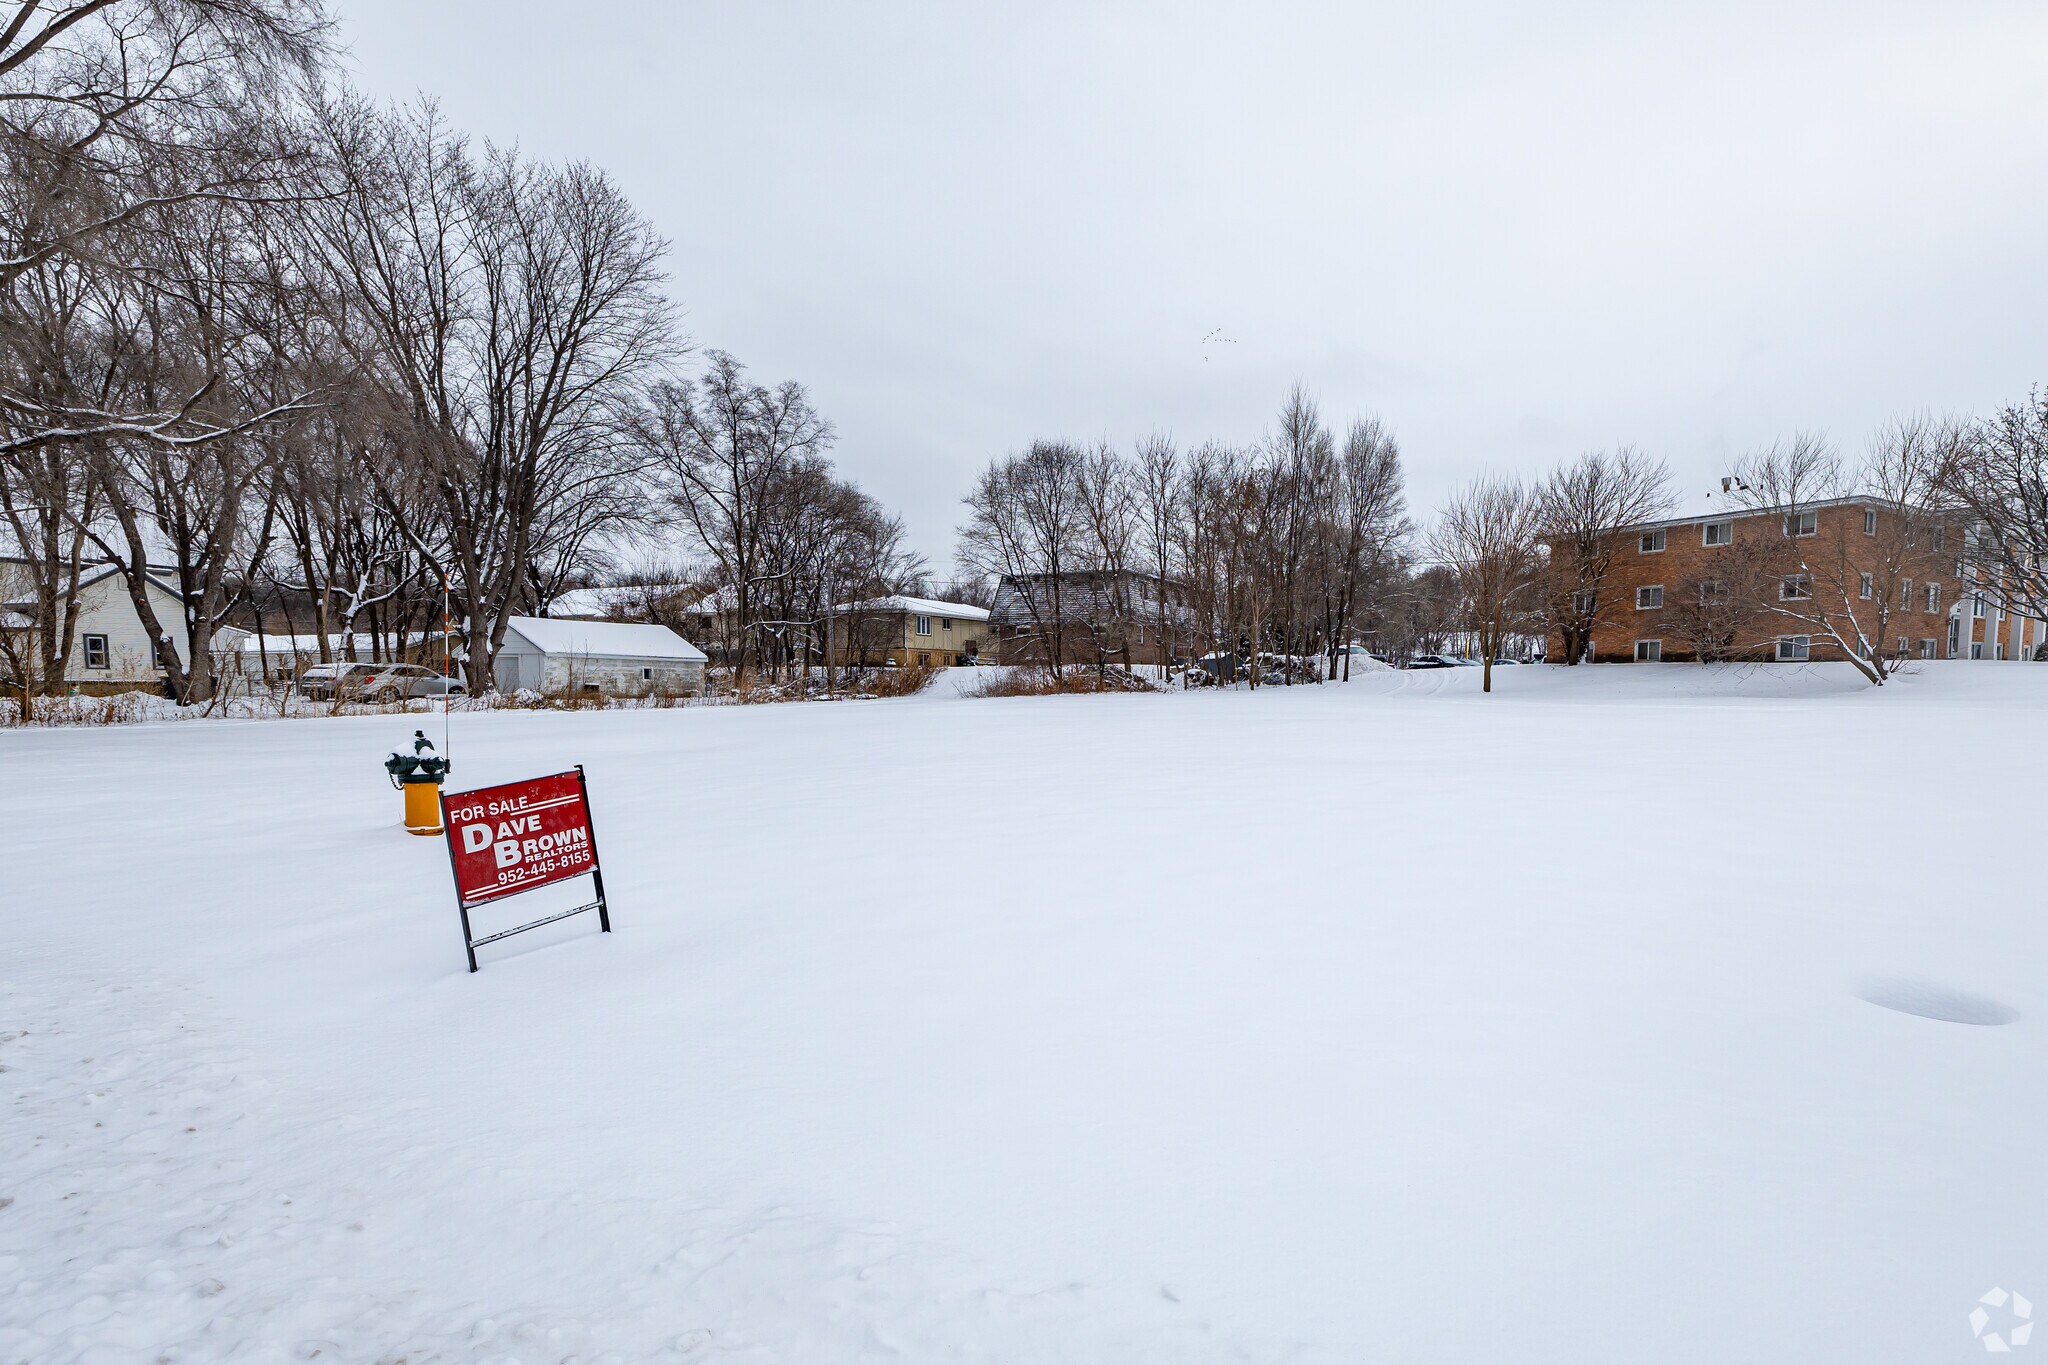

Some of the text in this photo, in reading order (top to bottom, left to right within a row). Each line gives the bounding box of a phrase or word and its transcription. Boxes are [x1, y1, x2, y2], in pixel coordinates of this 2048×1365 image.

[451, 796, 529, 823] FOR SALE
[461, 814, 542, 854] DAVE
[493, 826, 587, 868] BROWN
[498, 850, 590, 884] 952-445-8155
[525, 841, 588, 863] REALTORS
